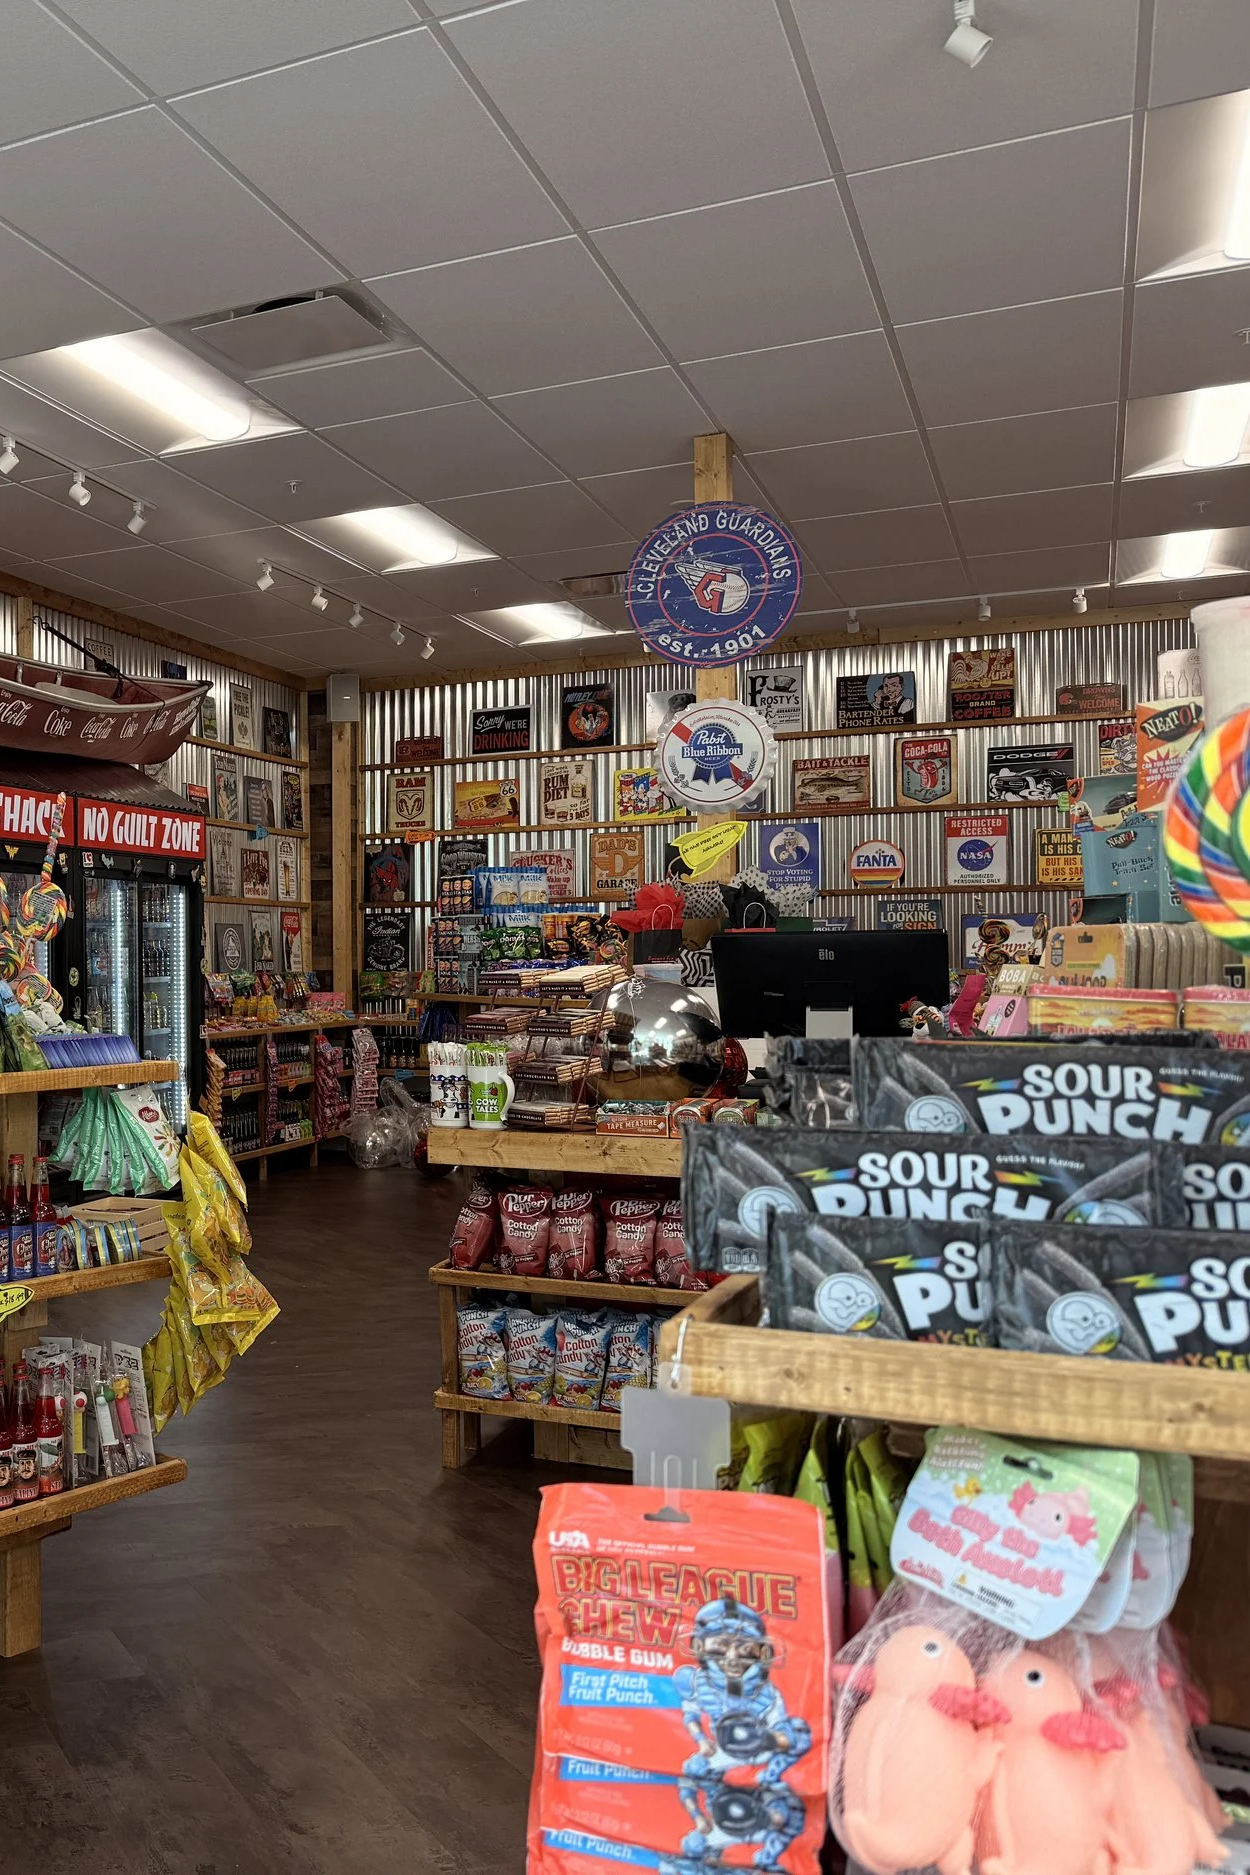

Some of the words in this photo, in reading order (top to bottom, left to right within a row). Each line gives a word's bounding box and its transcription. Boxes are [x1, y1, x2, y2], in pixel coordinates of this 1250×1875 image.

[636, 514, 710, 594] CLEVELAND
[715, 511, 792, 580] GUARDIANS
[657, 633, 699, 659] est.
[709, 624, 767, 658] 1901
[953, 690, 1011, 703] ROOSTER
[1082, 686, 1116, 695] BROWNS
[969, 700, 996, 708] BRAND
[1078, 698, 1120, 710] WELCOME
[838, 709, 895, 719] BARTENDER
[953, 706, 1012, 720] COFFEE
[474, 714, 505, 733] Sorry
[504, 719, 528, 730] WE'RE
[838, 718, 872, 728] PHONE
[872, 716, 904, 726] RATES
[1142, 702, 1198, 738] NEATO!
[473, 730, 529, 750] DRINKING
[696, 729, 726, 745] Pabst
[683, 746, 706, 758] Blue
[706, 745, 741, 757] Ribbon
[904, 741, 949, 759] COCA-COLA
[993, 751, 1058, 760] DODGE
[797, 760, 822, 769] BAIT
[829, 756, 868, 767] TACKLE
[395, 777, 426, 788] RAM
[951, 818, 1002, 828] RESTRICTED
[83, 807, 109, 842] NO
[112, 811, 158, 848] GUILT
[161, 817, 201, 853] ZONE
[960, 826, 993, 836] ACCESS
[959, 850, 992, 861] NASA
[1044, 844, 1054, 854] IS
[1057, 844, 1073, 854] HIS
[856, 853, 897, 867] FANTA
[1045, 857, 1062, 867] BUT
[1063, 857, 1077, 866] HIS
[786, 868, 813, 876] VOTING
[1041, 867, 1050, 877] IS
[1051, 867, 1067, 876] HIS
[886, 903, 896, 912] IF
[896, 902, 930, 911] YOU'RE
[880, 910, 937, 923] LOOKING
[998, 968, 1027, 984] BOBA
[1022, 1062, 1155, 1102] SOUR
[475, 1098, 498, 1106] COW
[475, 1105, 499, 1113] TALES
[606, 1121, 623, 1130] TAPE
[625, 1119, 658, 1129] MEASURE
[976, 1093, 1213, 1145] PUNCH
[857, 1150, 993, 1192] SOUR
[811, 1182, 1052, 1222] PUNCH
[507, 1219, 538, 1231] Cotton
[507, 1228, 537, 1241] Candy
[565, 1337, 598, 1352] Cotton
[550, 1554, 621, 1599] BIG
[623, 1560, 798, 1620] LEAGUE
[558, 1597, 682, 1649] CHEW
[561, 1639, 625, 1664] BUBBLE
[629, 1646, 675, 1671] GUM
[571, 1671, 608, 1690] First
[609, 1673, 648, 1690] Pitch
[568, 1684, 603, 1702] Fruit
[605, 1687, 654, 1706] Punch
